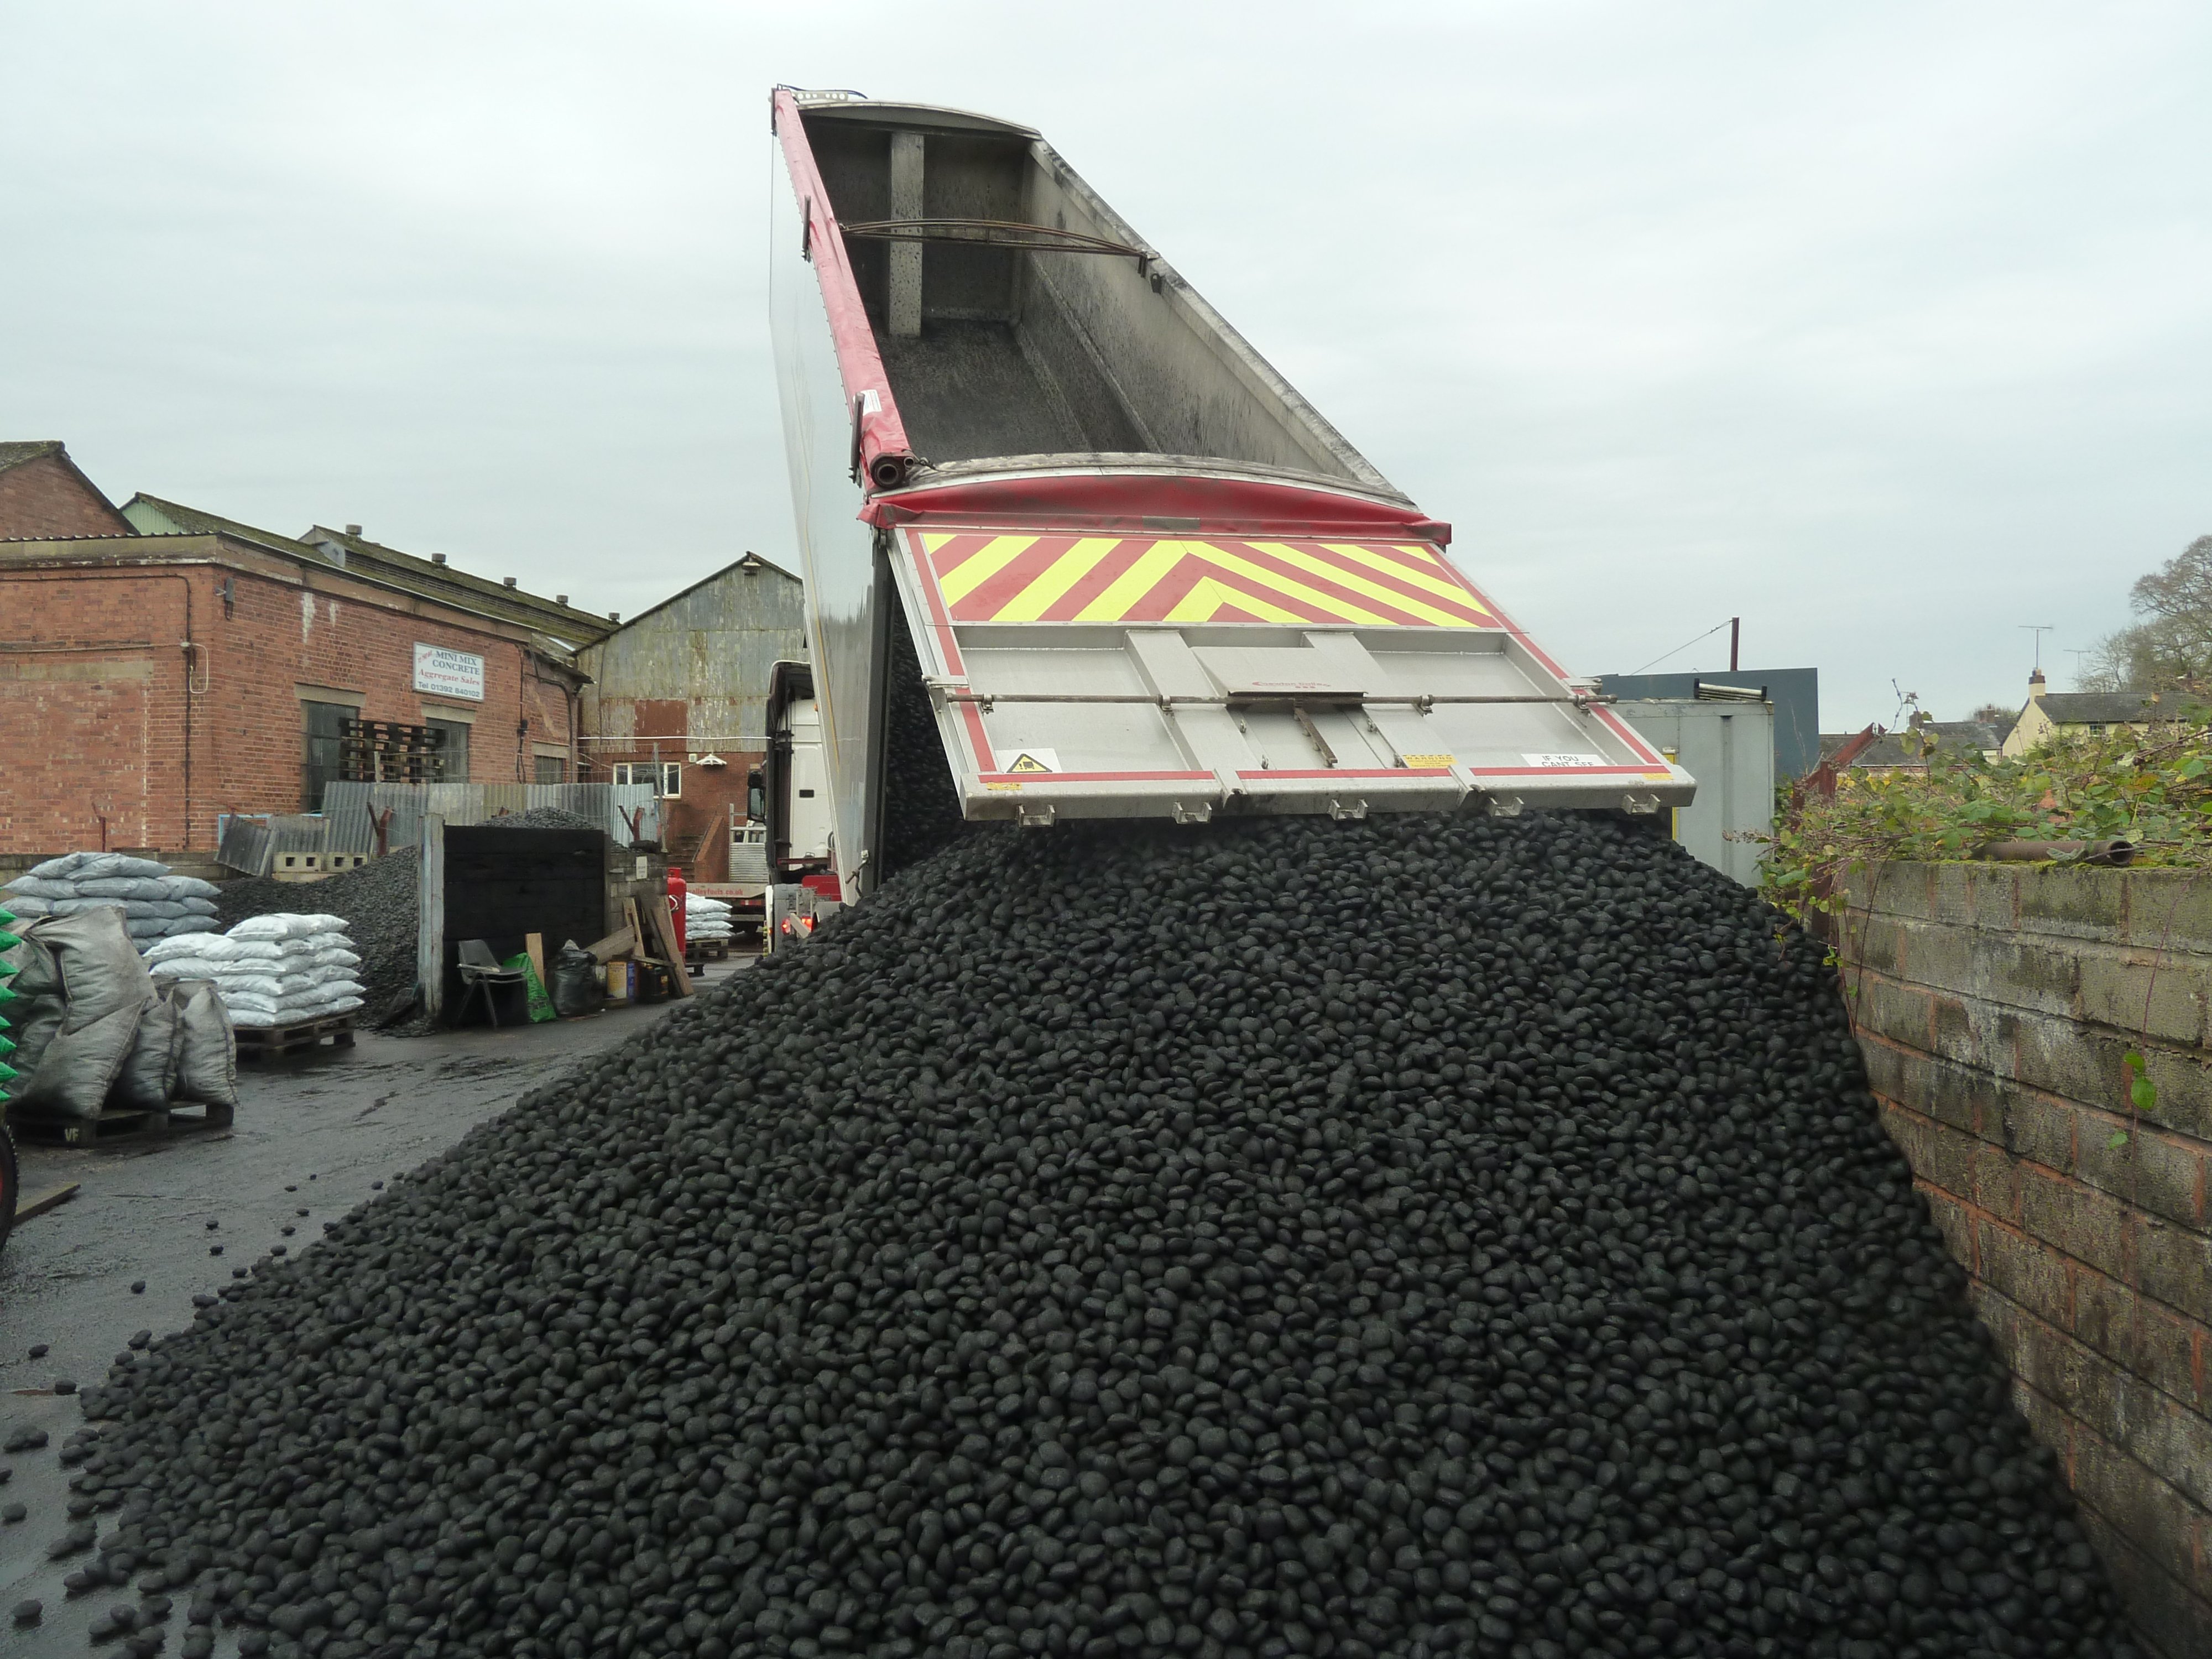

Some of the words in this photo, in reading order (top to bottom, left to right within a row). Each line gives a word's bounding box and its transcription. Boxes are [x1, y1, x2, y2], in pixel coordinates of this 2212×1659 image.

[436, 650, 457, 662] MINI
[460, 655, 477, 666] MIX
[432, 659, 480, 675] CONCRETE
[418, 669, 458, 682] Aggregate
[461, 676, 480, 686] Sales
[431, 684, 453, 693] 01392
[455, 688, 480, 697] 840102
